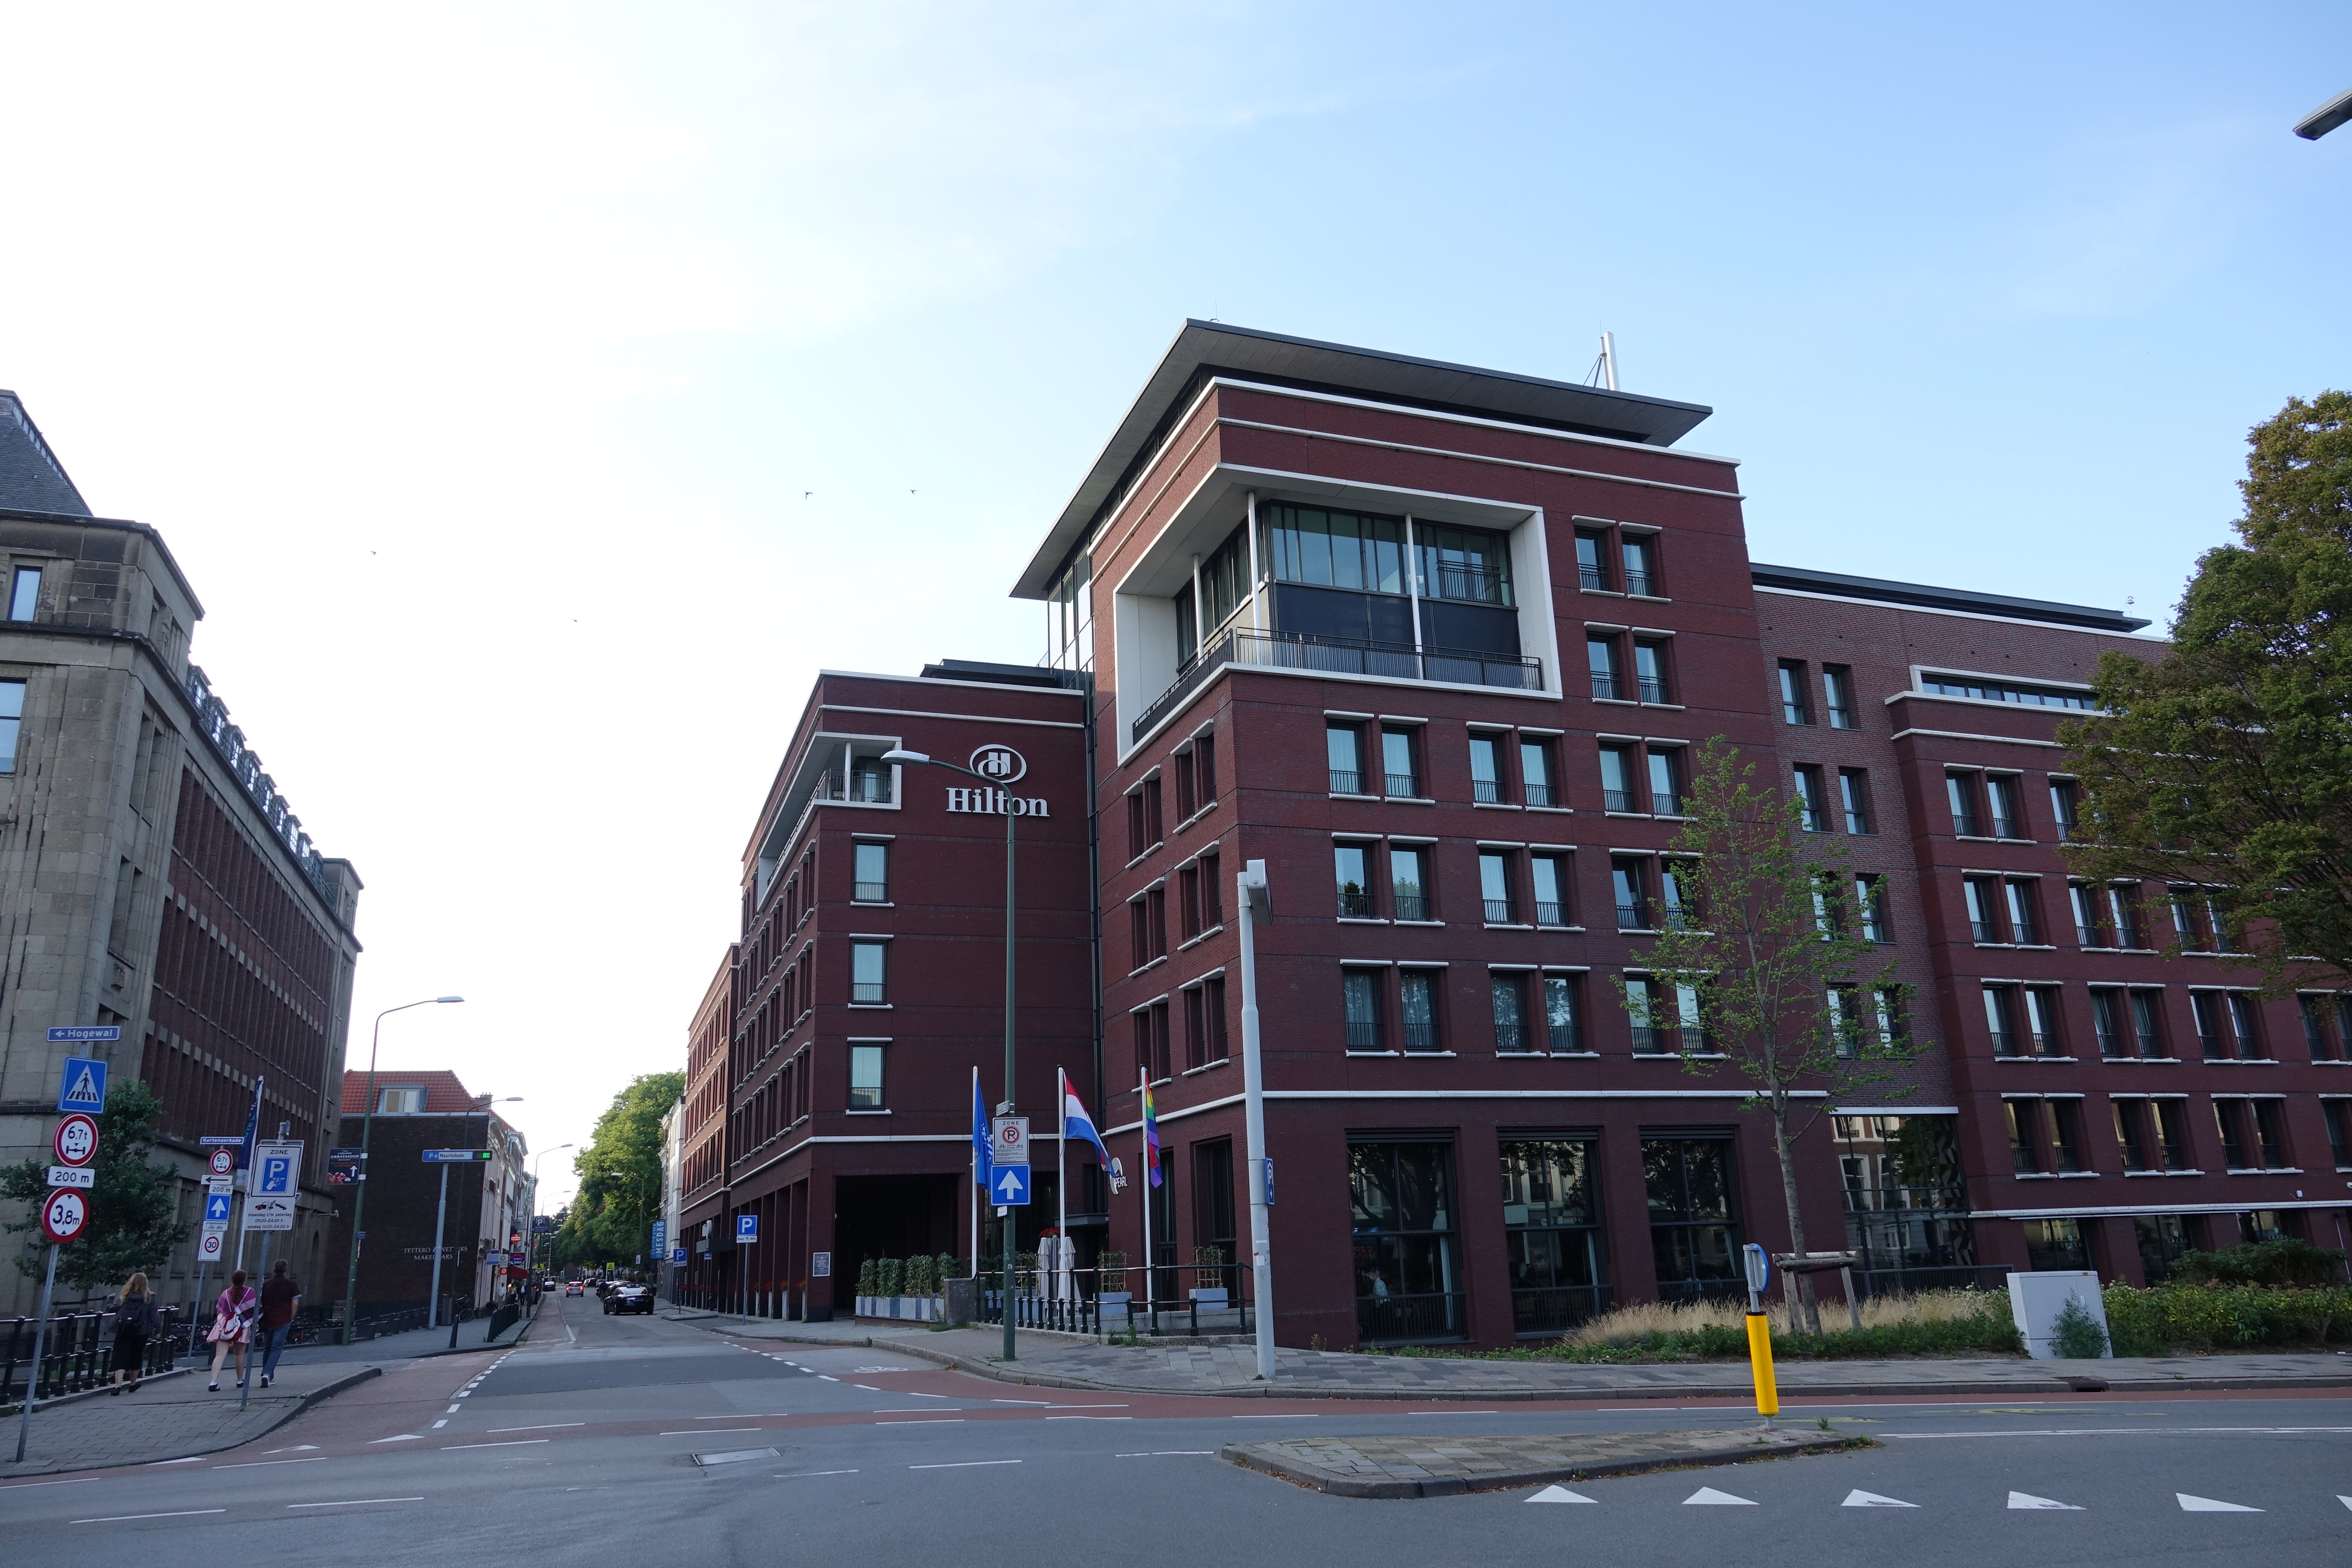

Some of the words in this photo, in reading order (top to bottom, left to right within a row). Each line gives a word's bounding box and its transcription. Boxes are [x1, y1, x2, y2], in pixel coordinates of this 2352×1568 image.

[946, 787, 1050, 817] Hilton
[68, 1029, 113, 1039] Hogewal
[68, 1126, 88, 1140] 6,7t
[269, 1161, 285, 1178] P
[55, 1171, 77, 1182] 200
[80, 1175, 90, 1183] m
[1115, 1176, 1128, 1187] PEARL
[53, 1204, 80, 1226] 3,8m
[742, 1218, 753, 1233] P
[655, 1221, 664, 1254] MESDAG
[677, 1250, 684, 1260] P
